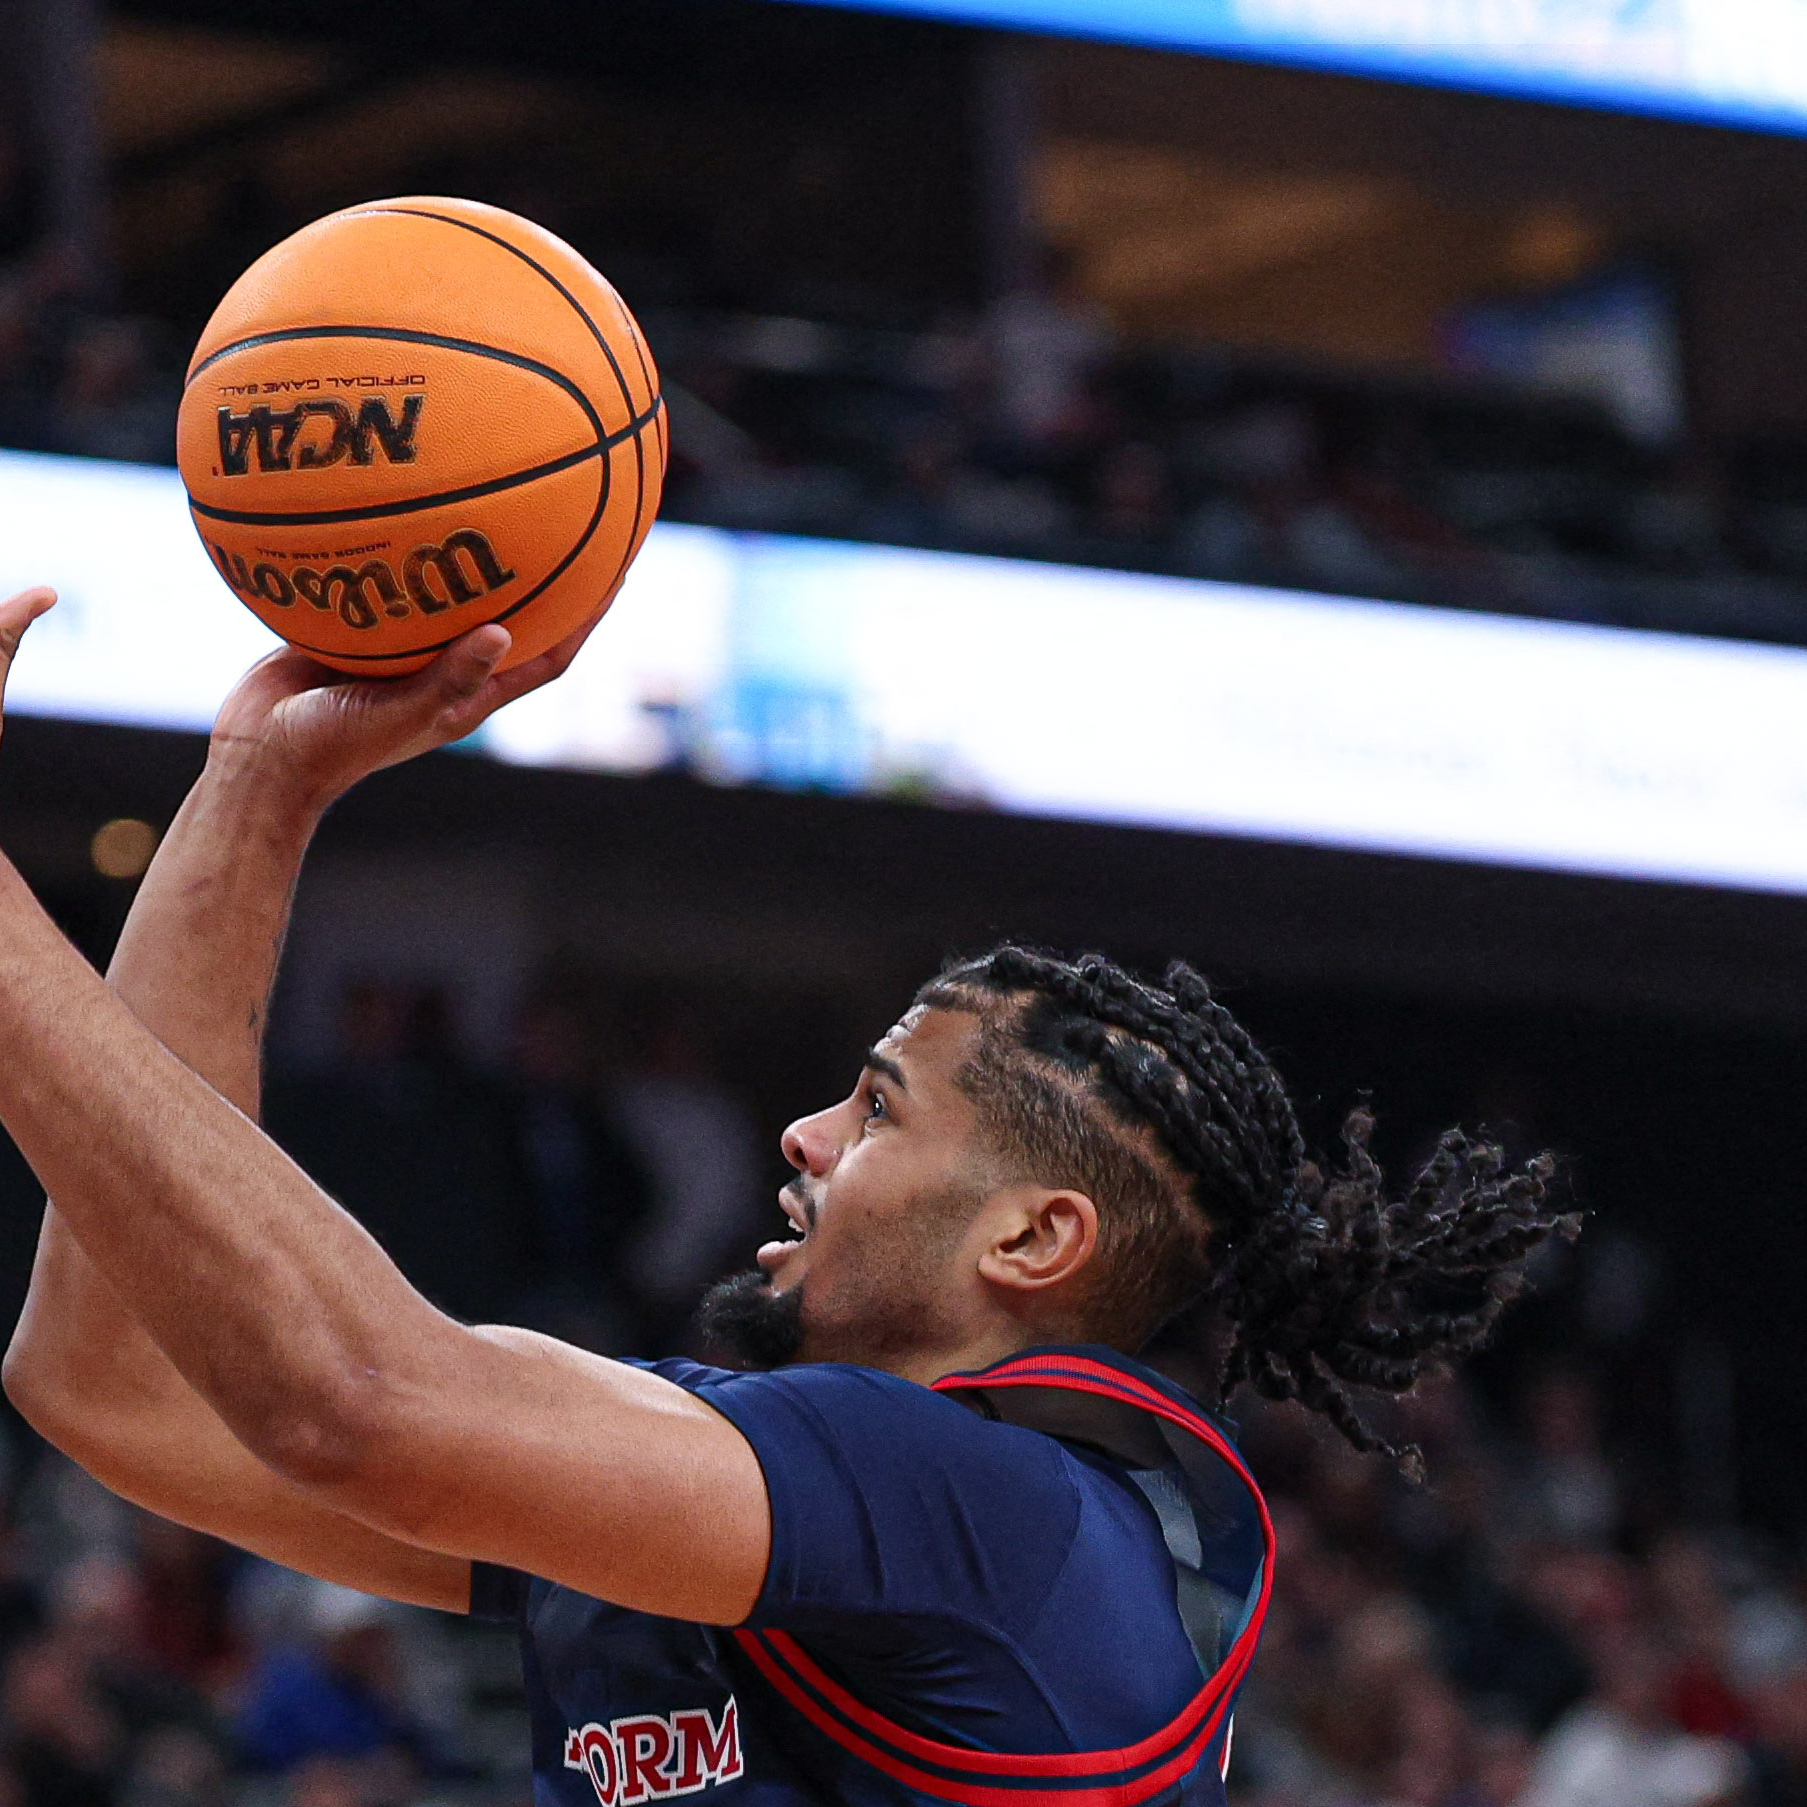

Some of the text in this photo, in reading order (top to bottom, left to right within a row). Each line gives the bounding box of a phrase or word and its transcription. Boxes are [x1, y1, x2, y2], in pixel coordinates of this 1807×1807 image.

[218, 374, 426, 396] OFFICIAL GAME BALL
[216, 393, 427, 478] NCAA
[333, 540, 391, 558] INDOOR
[203, 528, 518, 631] Wilson
